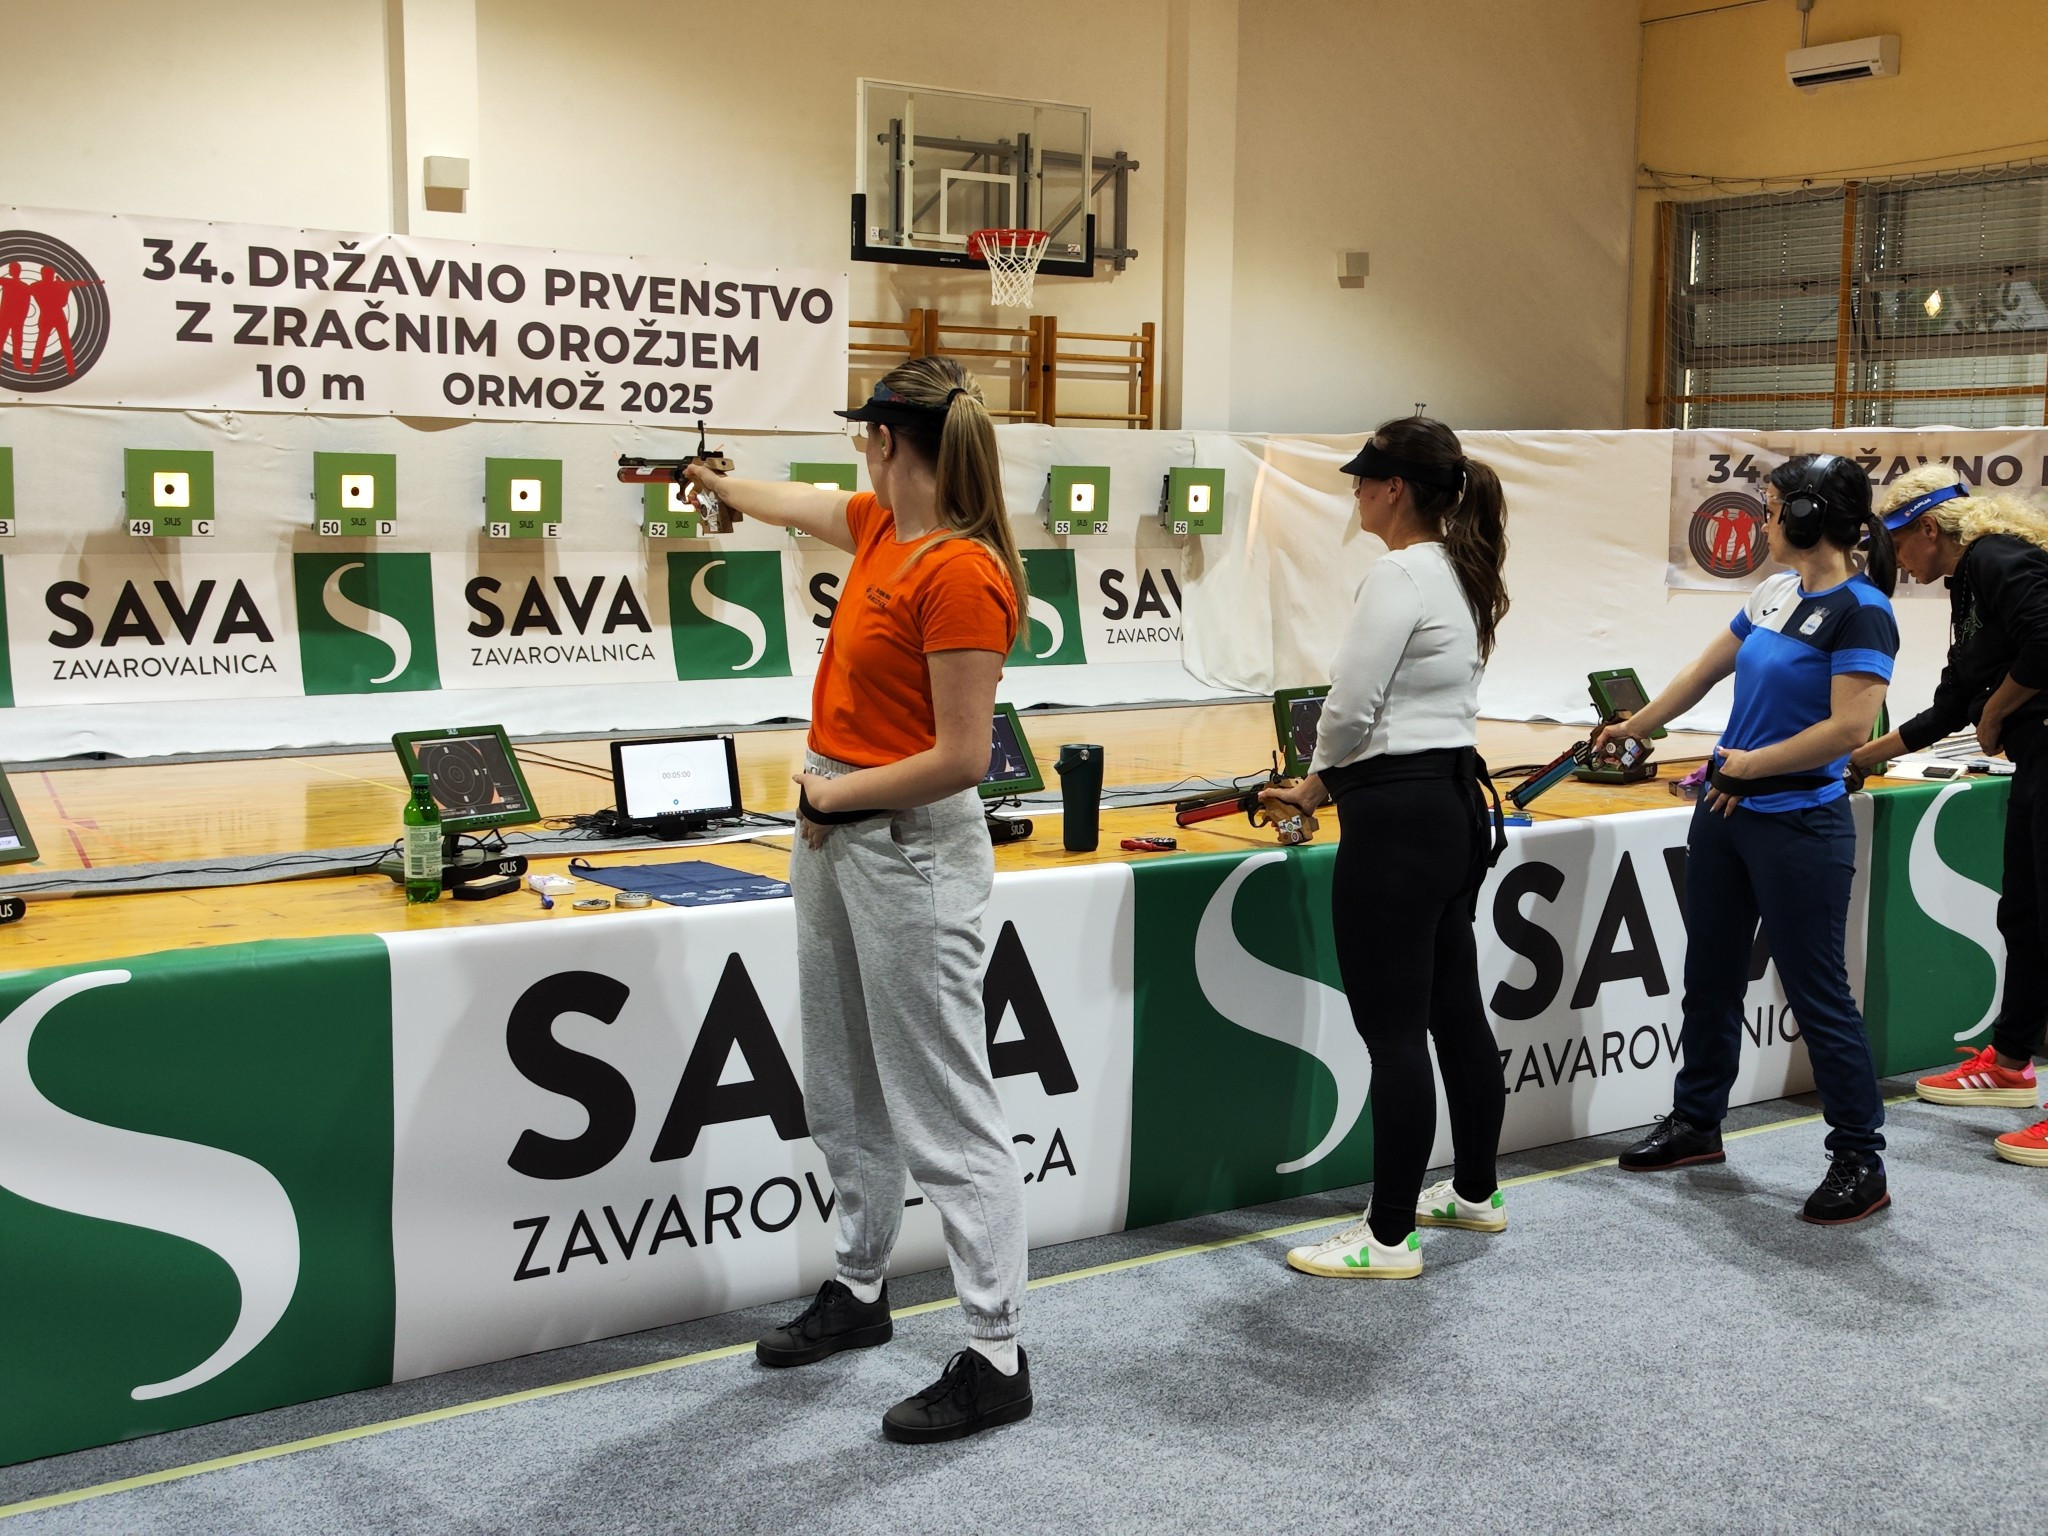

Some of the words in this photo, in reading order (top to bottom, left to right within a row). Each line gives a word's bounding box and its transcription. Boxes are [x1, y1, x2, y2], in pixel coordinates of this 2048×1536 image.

[142, 238, 235, 285] 34.
[248, 241, 526, 304] DRŽAVNO
[545, 267, 834, 325] PRVENSTVO
[175, 300, 213, 343] Z
[233, 299, 497, 357] ZRAČNIM
[517, 318, 760, 372] OROŽJEM
[256, 363, 306, 400] 10
[322, 373, 365, 402] m
[442, 370, 605, 412] ORMOŽ
[619, 380, 714, 415] 2025
[132, 521, 151, 535] 49
[197, 521, 209, 535] C
[322, 521, 339, 535] 50
[381, 522, 392, 535] D
[492, 523, 508, 536] 51
[547, 524, 558, 537] E
[650, 523, 666, 536] 52
[1056, 522, 1069, 533] 55
[1094, 522, 1108, 533] R2
[1175, 522, 1187, 533] 56
[465, 574, 653, 638] SAVA
[45, 579, 275, 649] SAVA
[471, 643, 656, 666] ZAVAROVALNICA
[53, 654, 278, 681] ZAVAROVALNICA
[662, 770, 692, 780] 00:05:00
[1011, 823, 1025, 836] SIUS
[499, 860, 518, 875] SIUS
[506, 920, 1080, 1181] SAA
